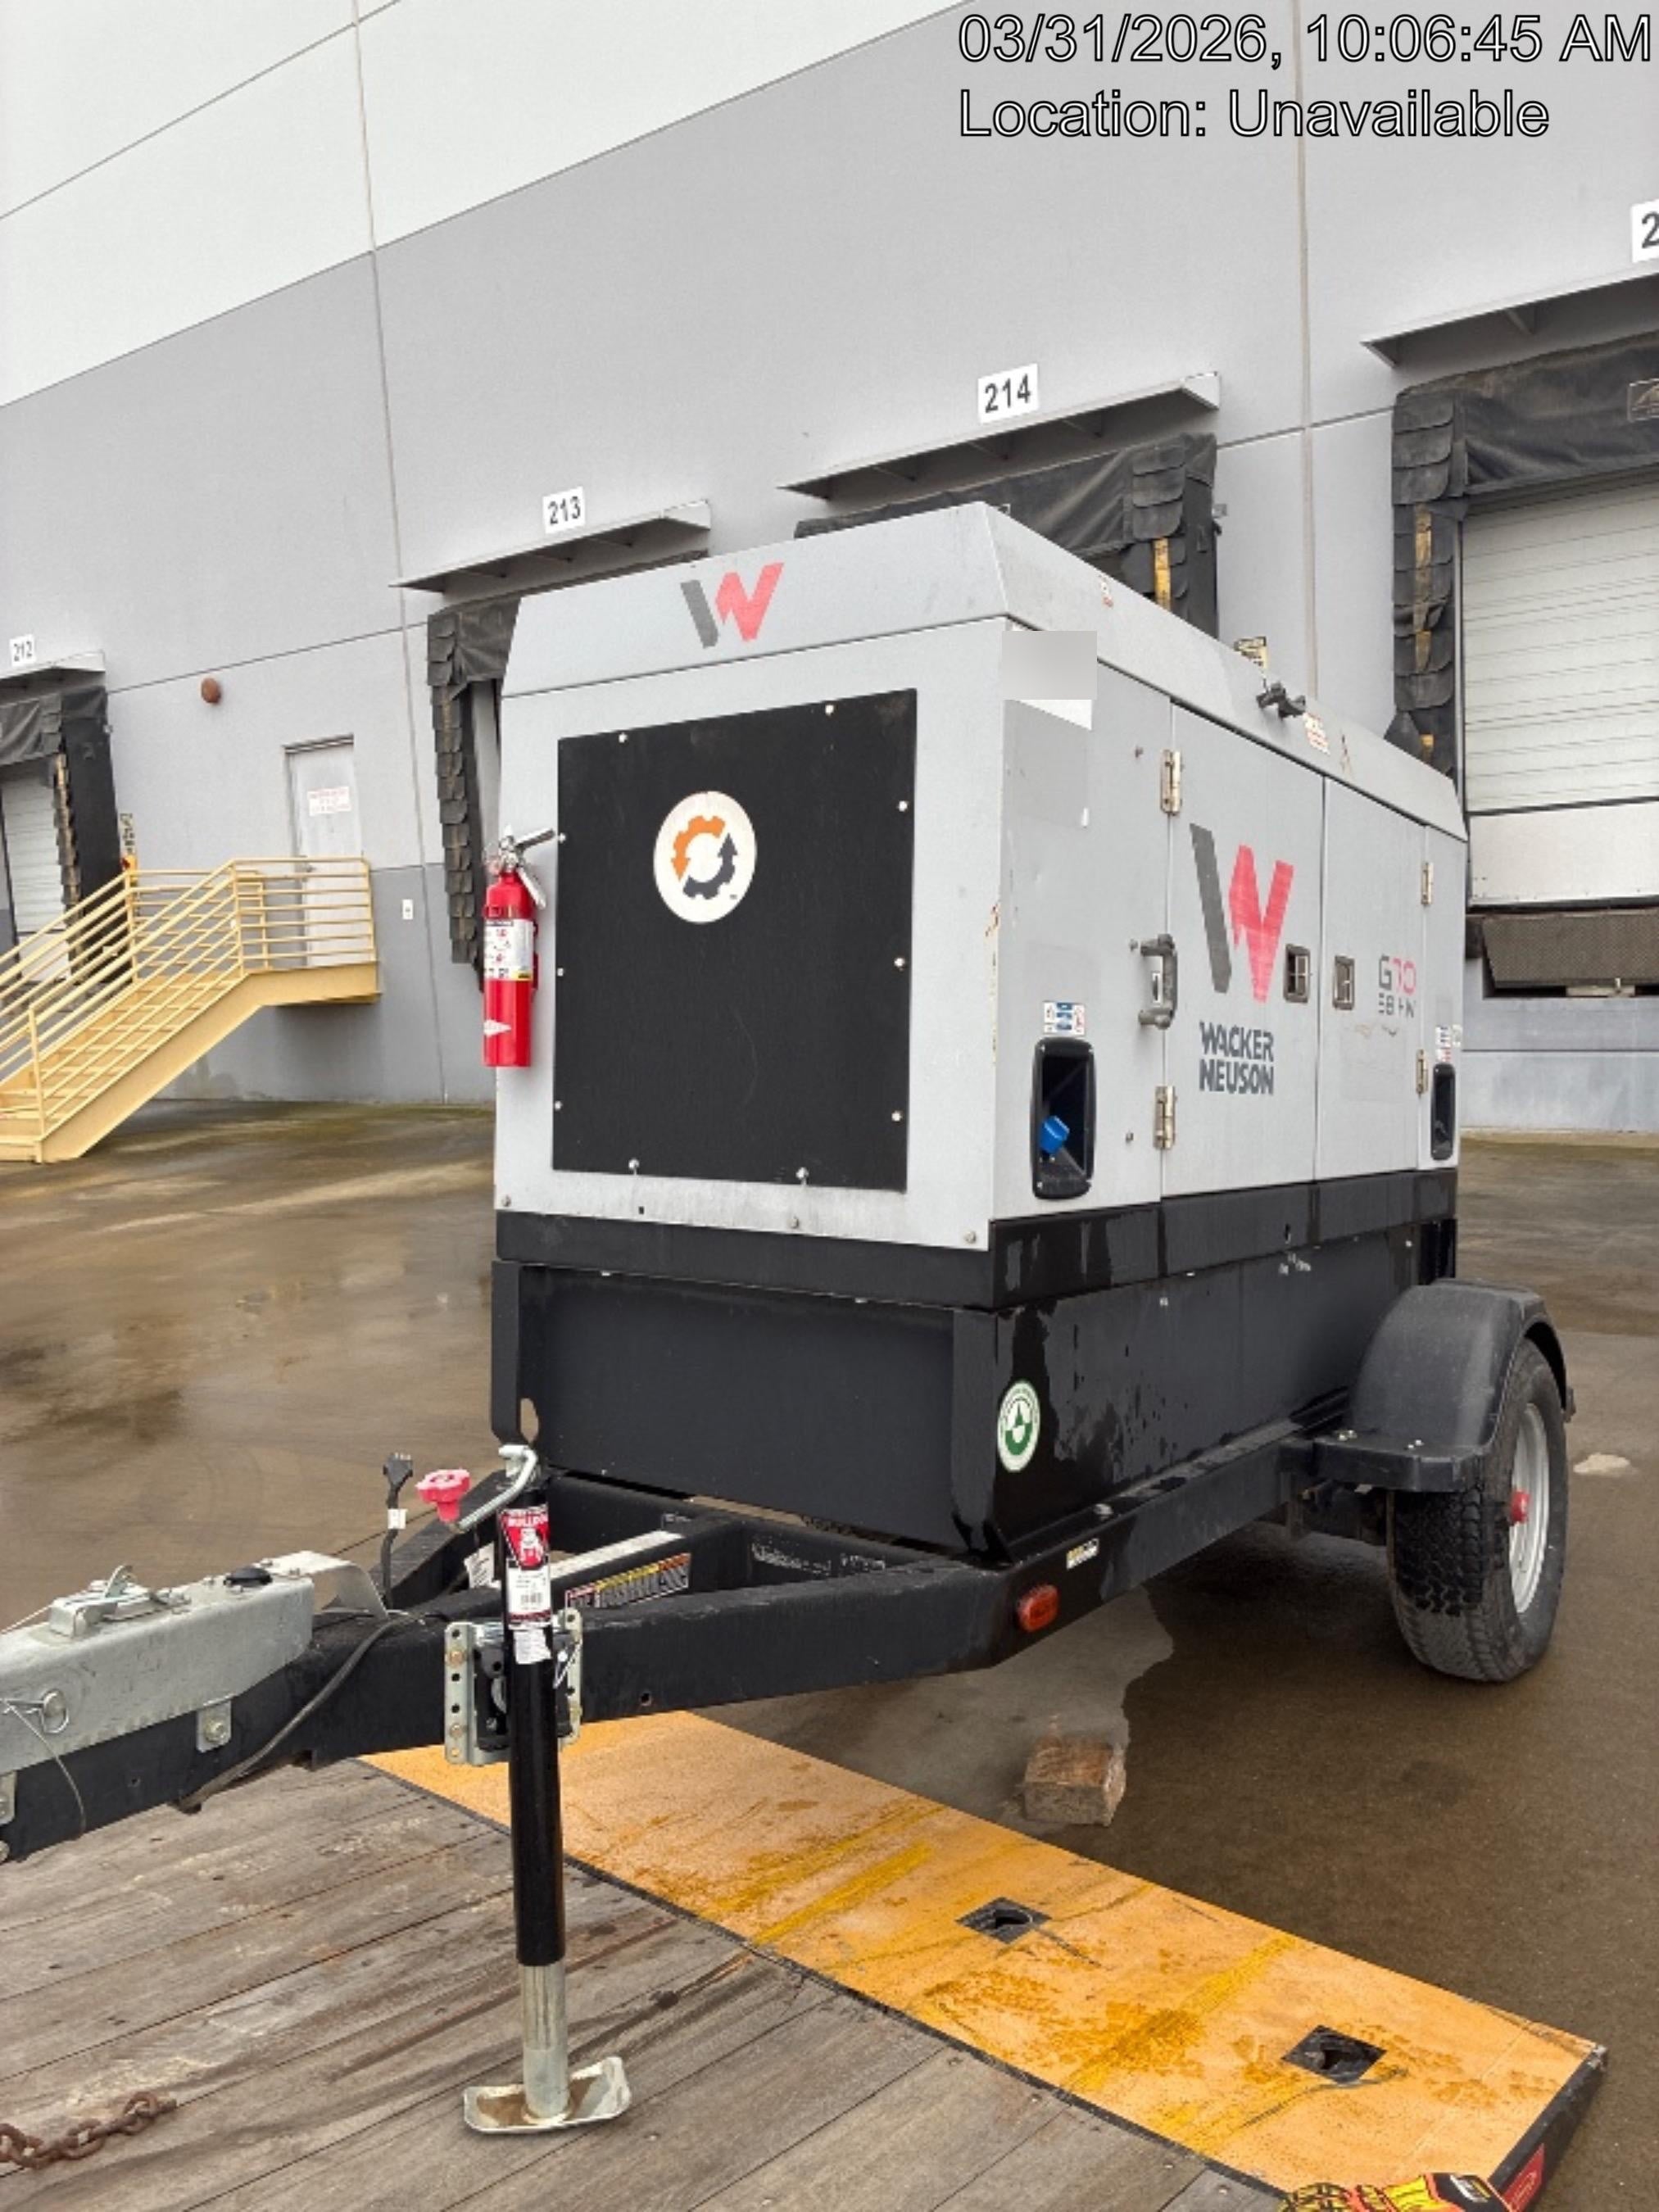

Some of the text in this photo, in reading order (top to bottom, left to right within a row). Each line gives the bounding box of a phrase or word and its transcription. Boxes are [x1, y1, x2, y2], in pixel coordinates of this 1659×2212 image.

[985, 373, 1031, 413] 214
[547, 496, 581, 525] 213
[14, 640, 33, 662] 212
[1379, 954, 1416, 994] G70
[1199, 1020, 1274, 1063] WACKER
[1199, 1058, 1274, 1095] NEUSON
